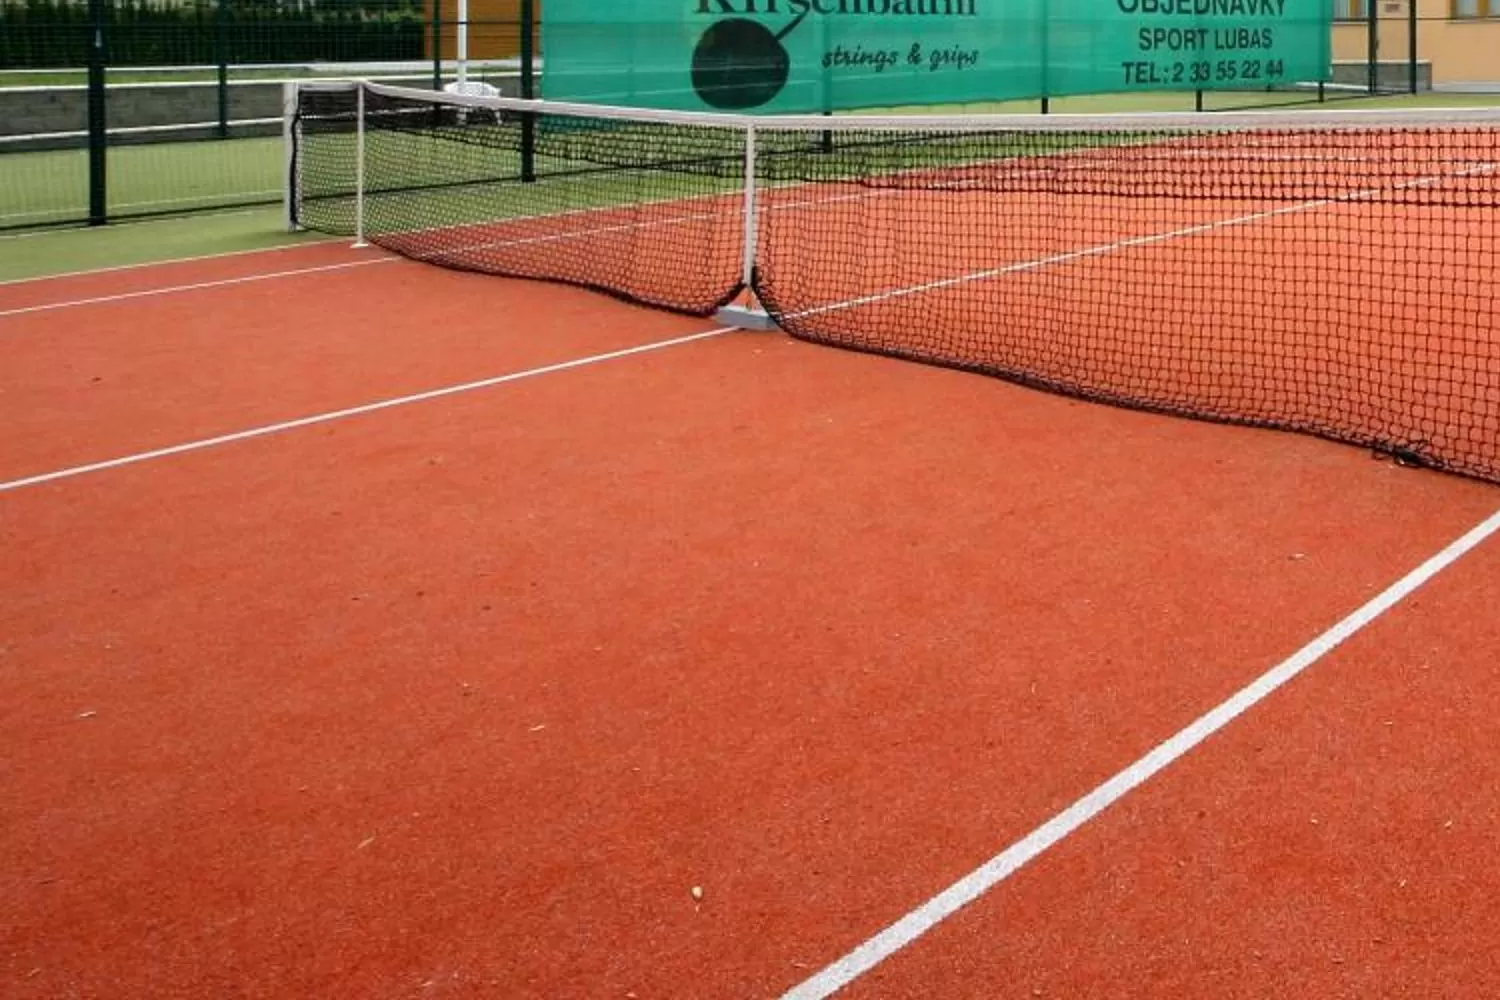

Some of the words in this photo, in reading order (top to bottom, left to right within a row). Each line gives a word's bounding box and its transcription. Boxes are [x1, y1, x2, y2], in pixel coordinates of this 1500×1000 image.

[1138, 28, 1209, 51] SPORT
[1214, 28, 1273, 50] LUBAS
[821, 46, 897, 70] strings
[929, 47, 979, 73] grips
[1189, 62, 1211, 82] 33
[1215, 60, 1238, 81] 55
[1241, 60, 1261, 79] 22
[1266, 58, 1284, 78] 44
